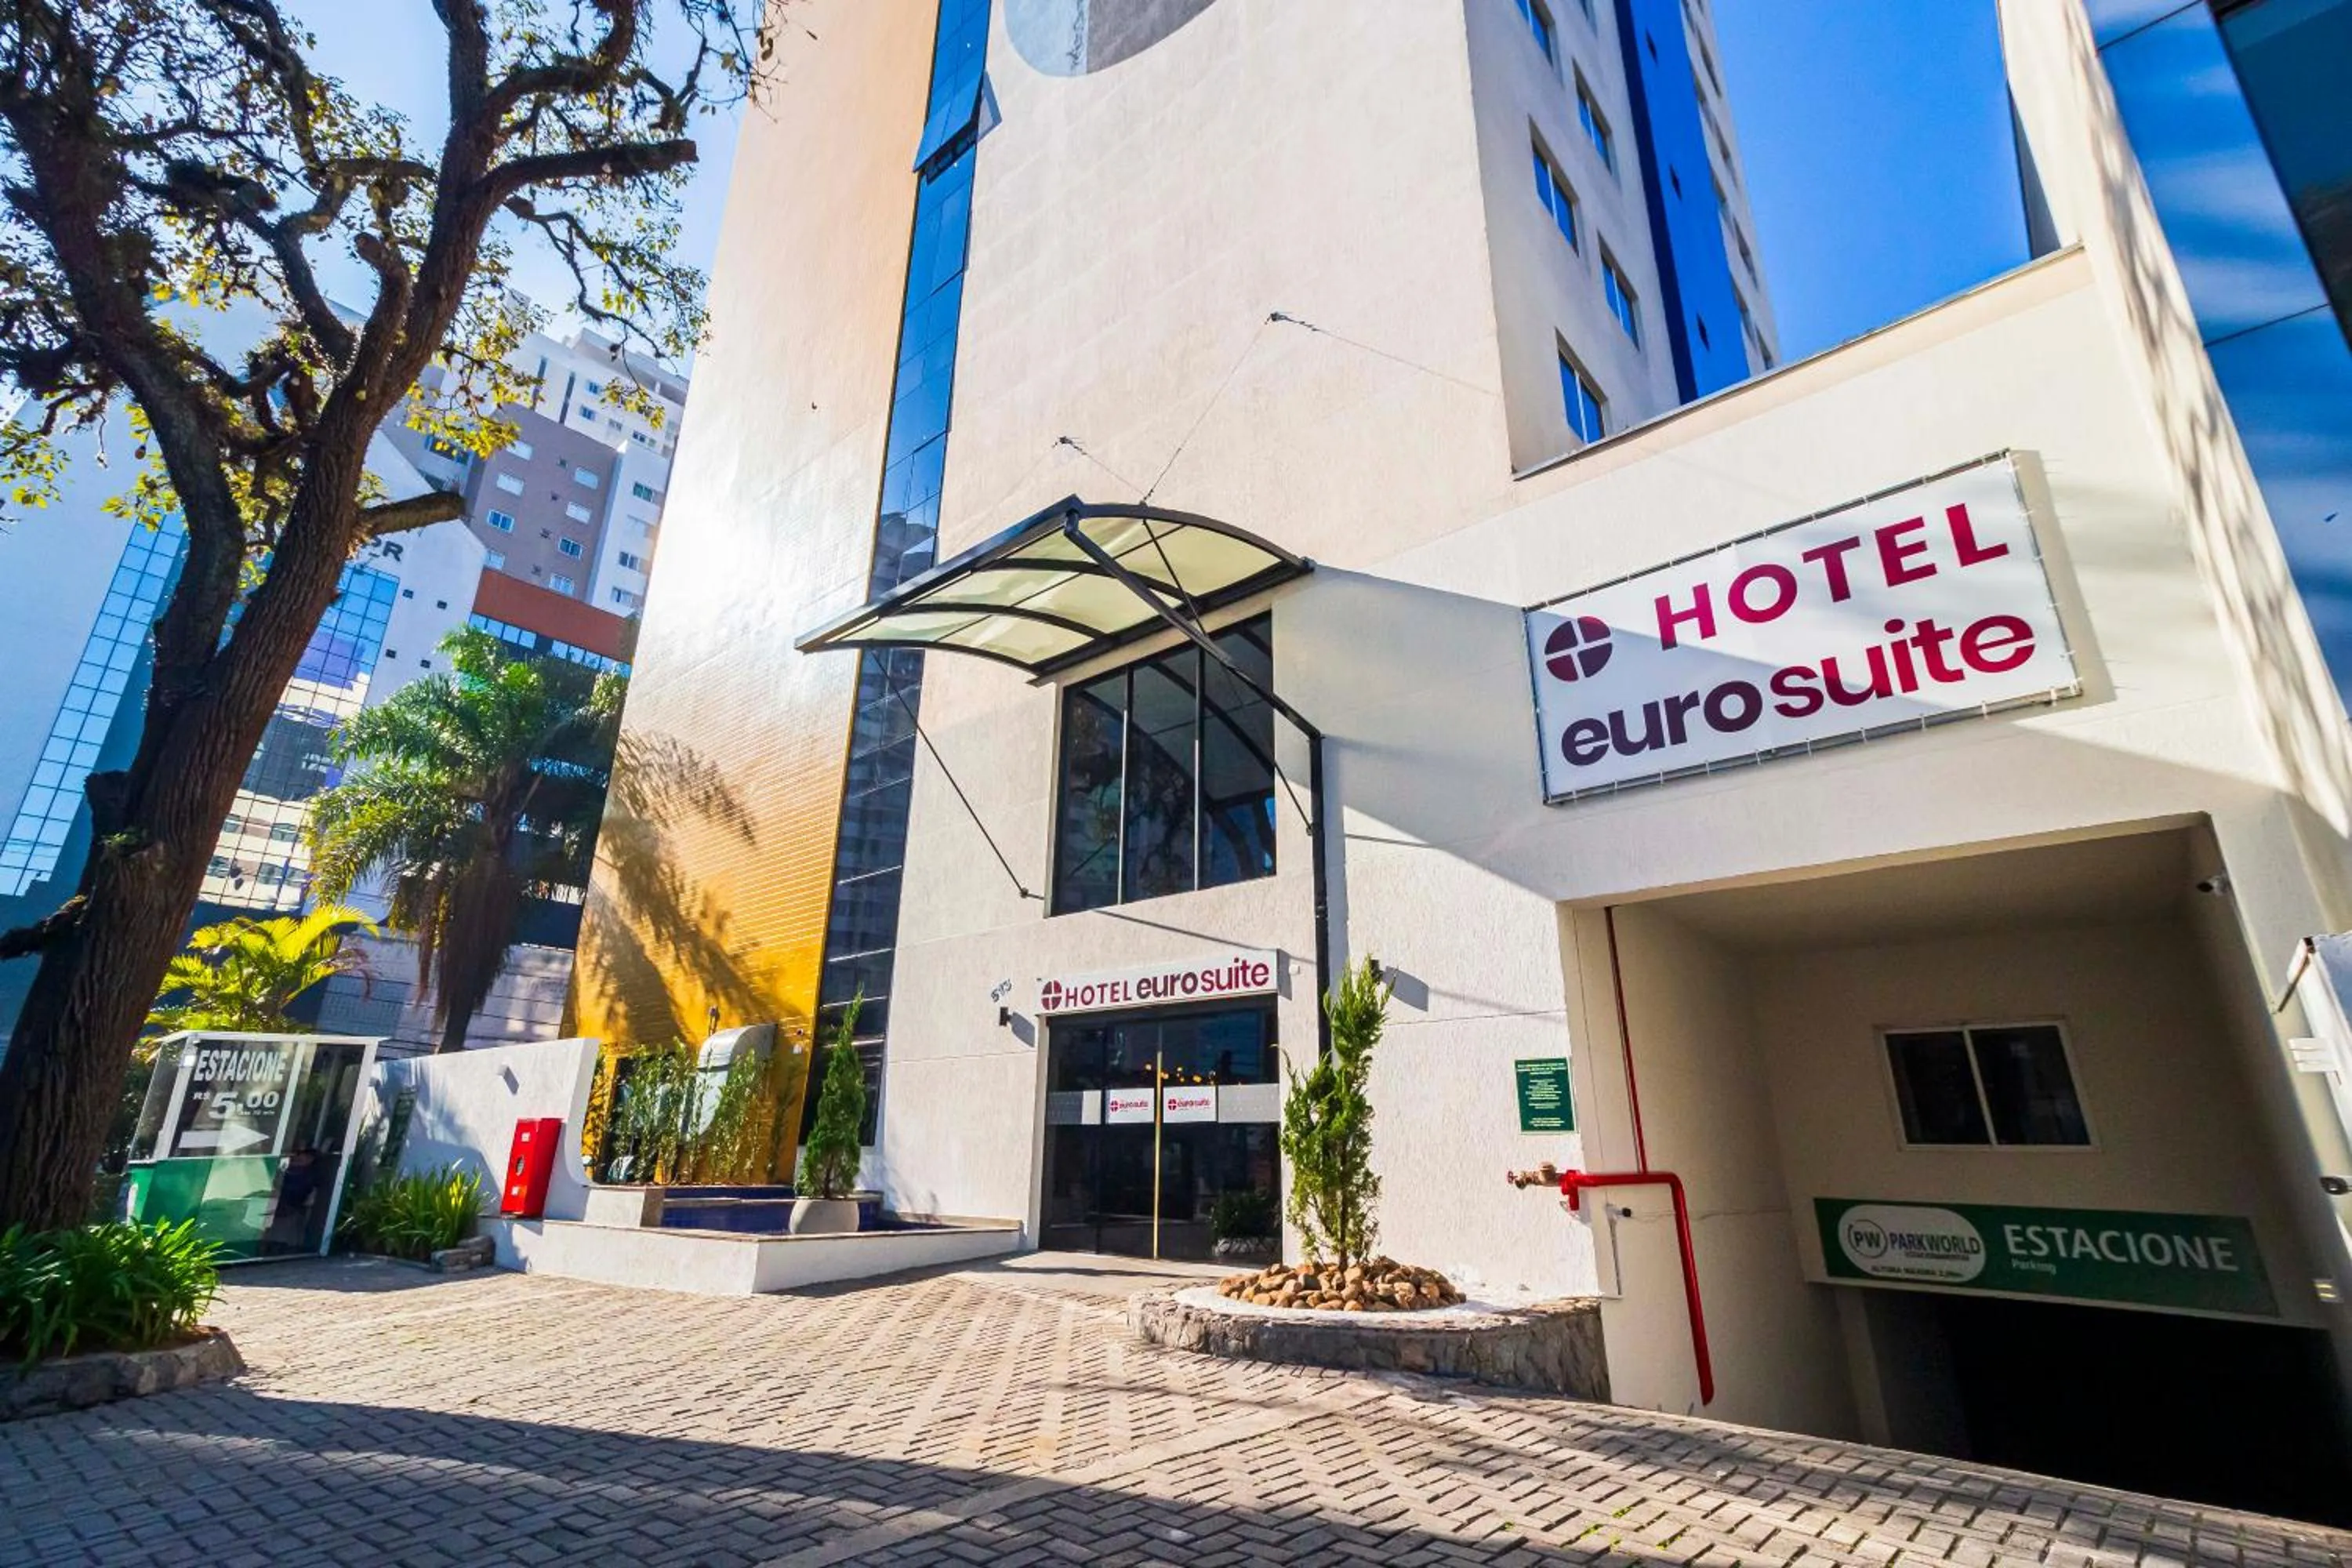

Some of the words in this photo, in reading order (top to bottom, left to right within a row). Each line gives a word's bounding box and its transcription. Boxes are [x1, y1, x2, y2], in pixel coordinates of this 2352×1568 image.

[1654, 503, 2009, 651] HOTEL
[1065, 980, 1133, 1007] HOTEL
[193, 1050, 289, 1081] ESTACIONE
[1853, 1230, 1882, 1249] PW
[1889, 1232, 1981, 1254] PARKWORLD
[2003, 1224, 2239, 1272] ESTACIONE
